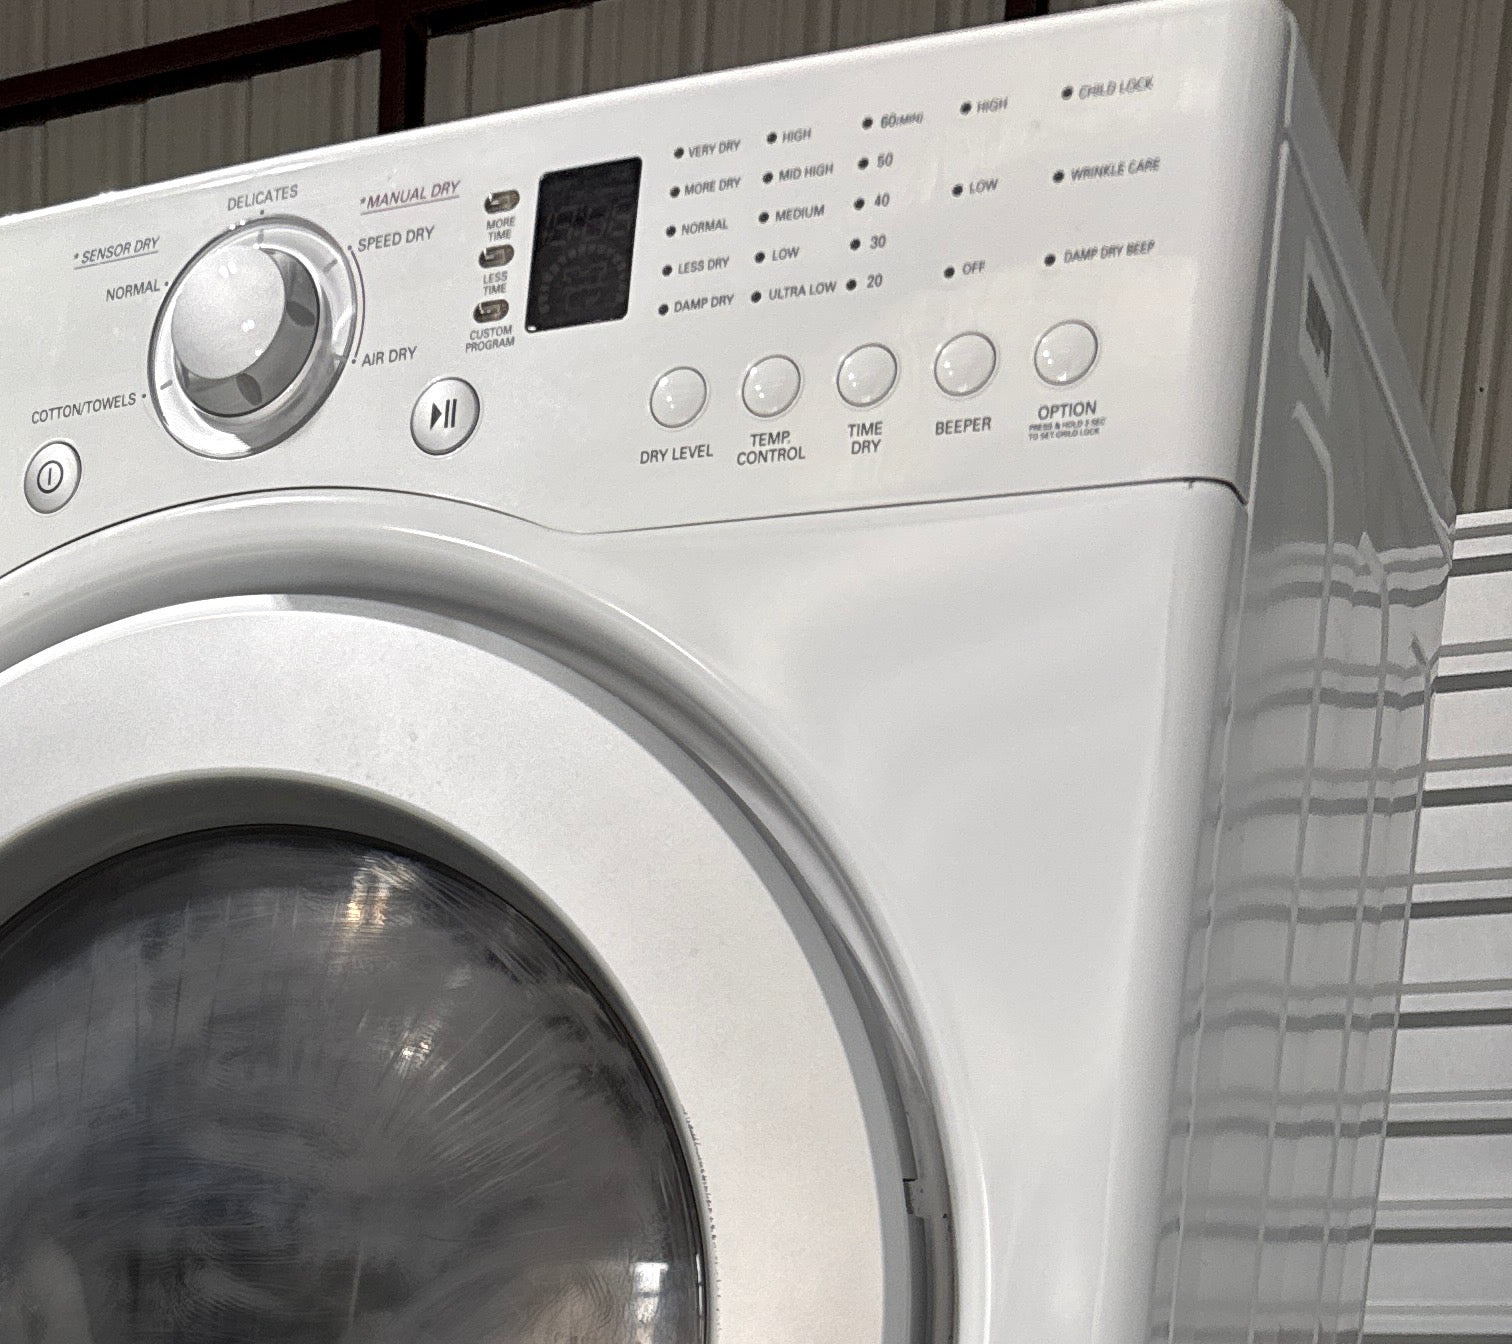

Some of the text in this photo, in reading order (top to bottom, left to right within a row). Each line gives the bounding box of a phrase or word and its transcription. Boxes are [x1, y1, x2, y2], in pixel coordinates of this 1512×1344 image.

[1078, 76, 1154, 100] CHILD LOCK
[977, 98, 1008, 113] HIGH
[782, 128, 811, 144] HIGH
[688, 139, 741, 159] VERY DRY
[779, 163, 834, 181] MID HIGH
[1071, 158, 1160, 181] WRINKLE CARE
[684, 178, 741, 197] MORE DRY
[969, 178, 998, 194] LOW
[227, 184, 298, 211] DELICATES
[370, 180, 461, 211] MANUAL DRY
[874, 193, 890, 208] 40
[486, 216, 515, 231] MORE
[775, 206, 825, 223] MEDIUM
[488, 227, 512, 241] TIME
[681, 219, 728, 237] NORMAL
[357, 226, 435, 252] SPEED DRY
[870, 234, 886, 250] 30
[80, 236, 160, 265] SENSOR DRY
[771, 247, 799, 262] LOW
[1064, 239, 1155, 264] DAMP DRY BEEP
[677, 257, 729, 276] LESS DRY
[962, 261, 985, 276] OFF
[483, 271, 508, 285] LESS
[867, 274, 883, 289] 20
[105, 279, 161, 302] NORMAL
[483, 282, 507, 296] TIME
[768, 280, 837, 301] ULTRA LOW
[674, 294, 735, 314] DAMP DRY
[469, 325, 513, 341] CUSTOM
[465, 336, 515, 353] PROGRAM
[361, 346, 418, 367] AIR DRY
[31, 391, 137, 425] COTTON/TOWELS
[1037, 401, 1097, 420] OPTION
[848, 421, 883, 437] TIME
[935, 417, 992, 436] BEEPER
[639, 444, 713, 465] DRY LEVEL
[736, 446, 806, 466] CONTROL
[851, 439, 881, 455] DRY
